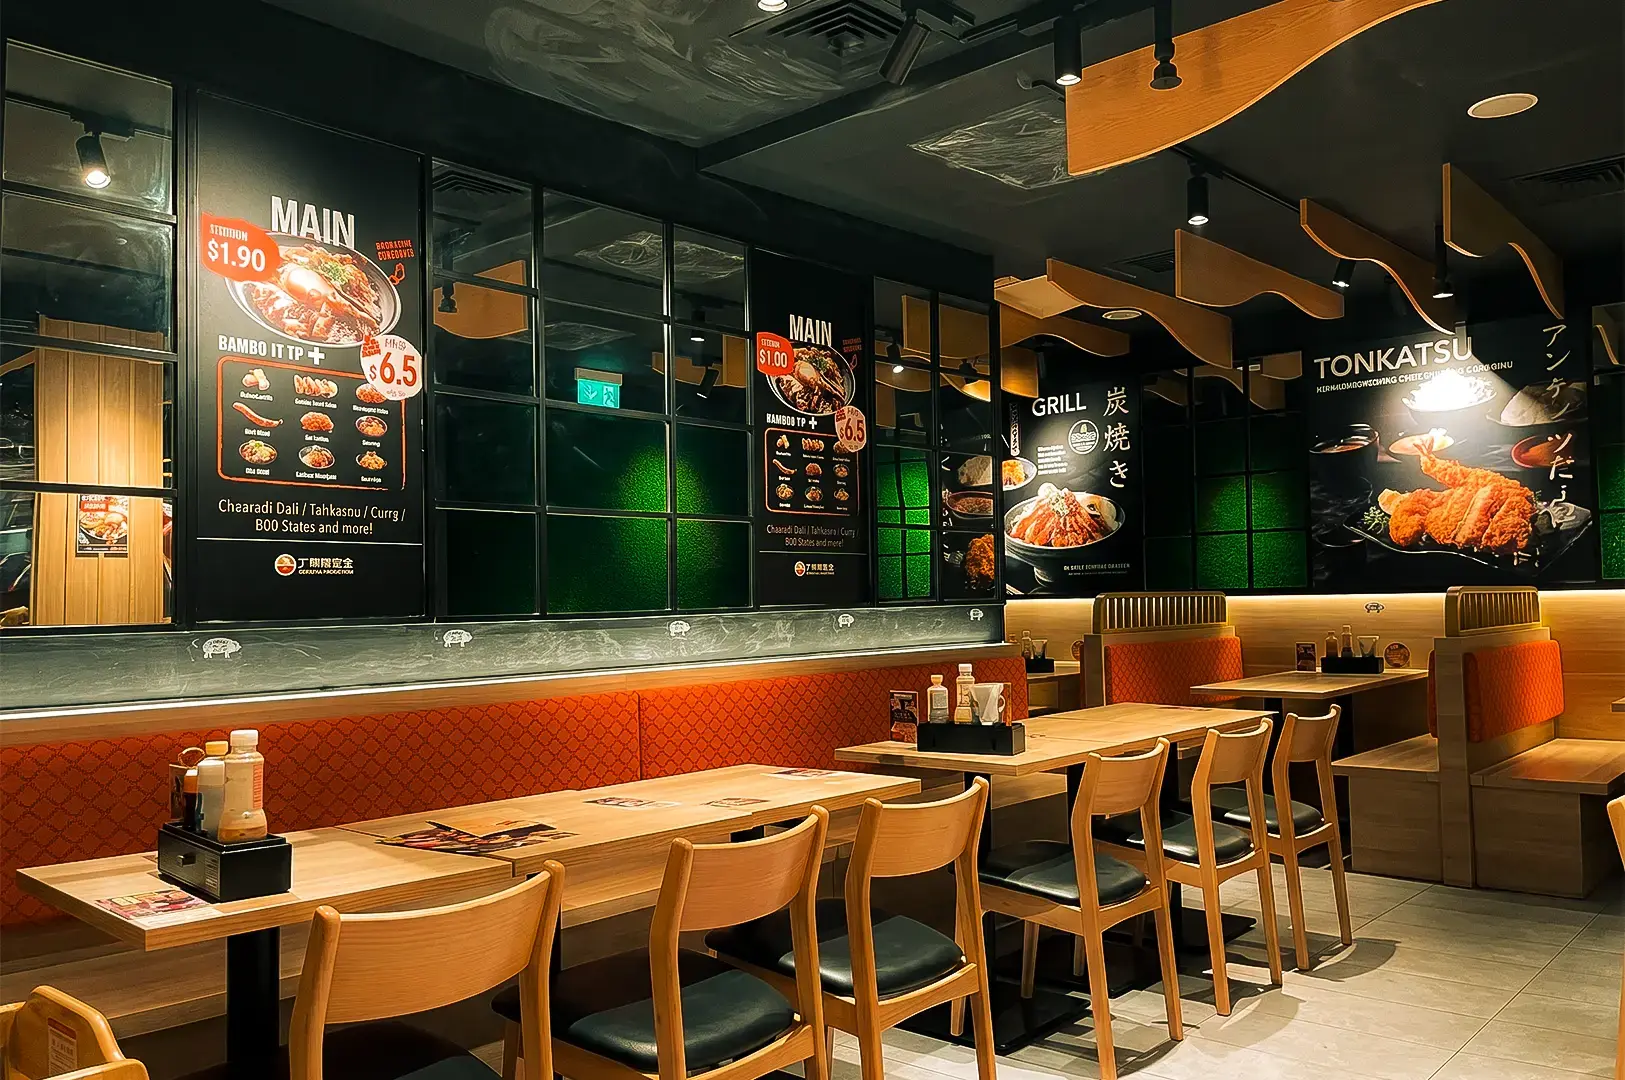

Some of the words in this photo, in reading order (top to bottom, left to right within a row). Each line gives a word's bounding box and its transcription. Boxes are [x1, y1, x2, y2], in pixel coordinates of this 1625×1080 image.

[271, 195, 355, 250] MAIN
[207, 238, 266, 272] $1.90
[789, 313, 832, 347] MAIN
[218, 334, 267, 357] BAMBO
[759, 349, 788, 368] $1.00
[1313, 336, 1472, 379] TONKATSU
[1032, 392, 1087, 417] GRILL
[1103, 386, 1131, 488] 炭焼き
[276, 501, 299, 515] Dali
[281, 520, 316, 533] States
[318, 521, 339, 534] and
[342, 522, 373, 535] more!
